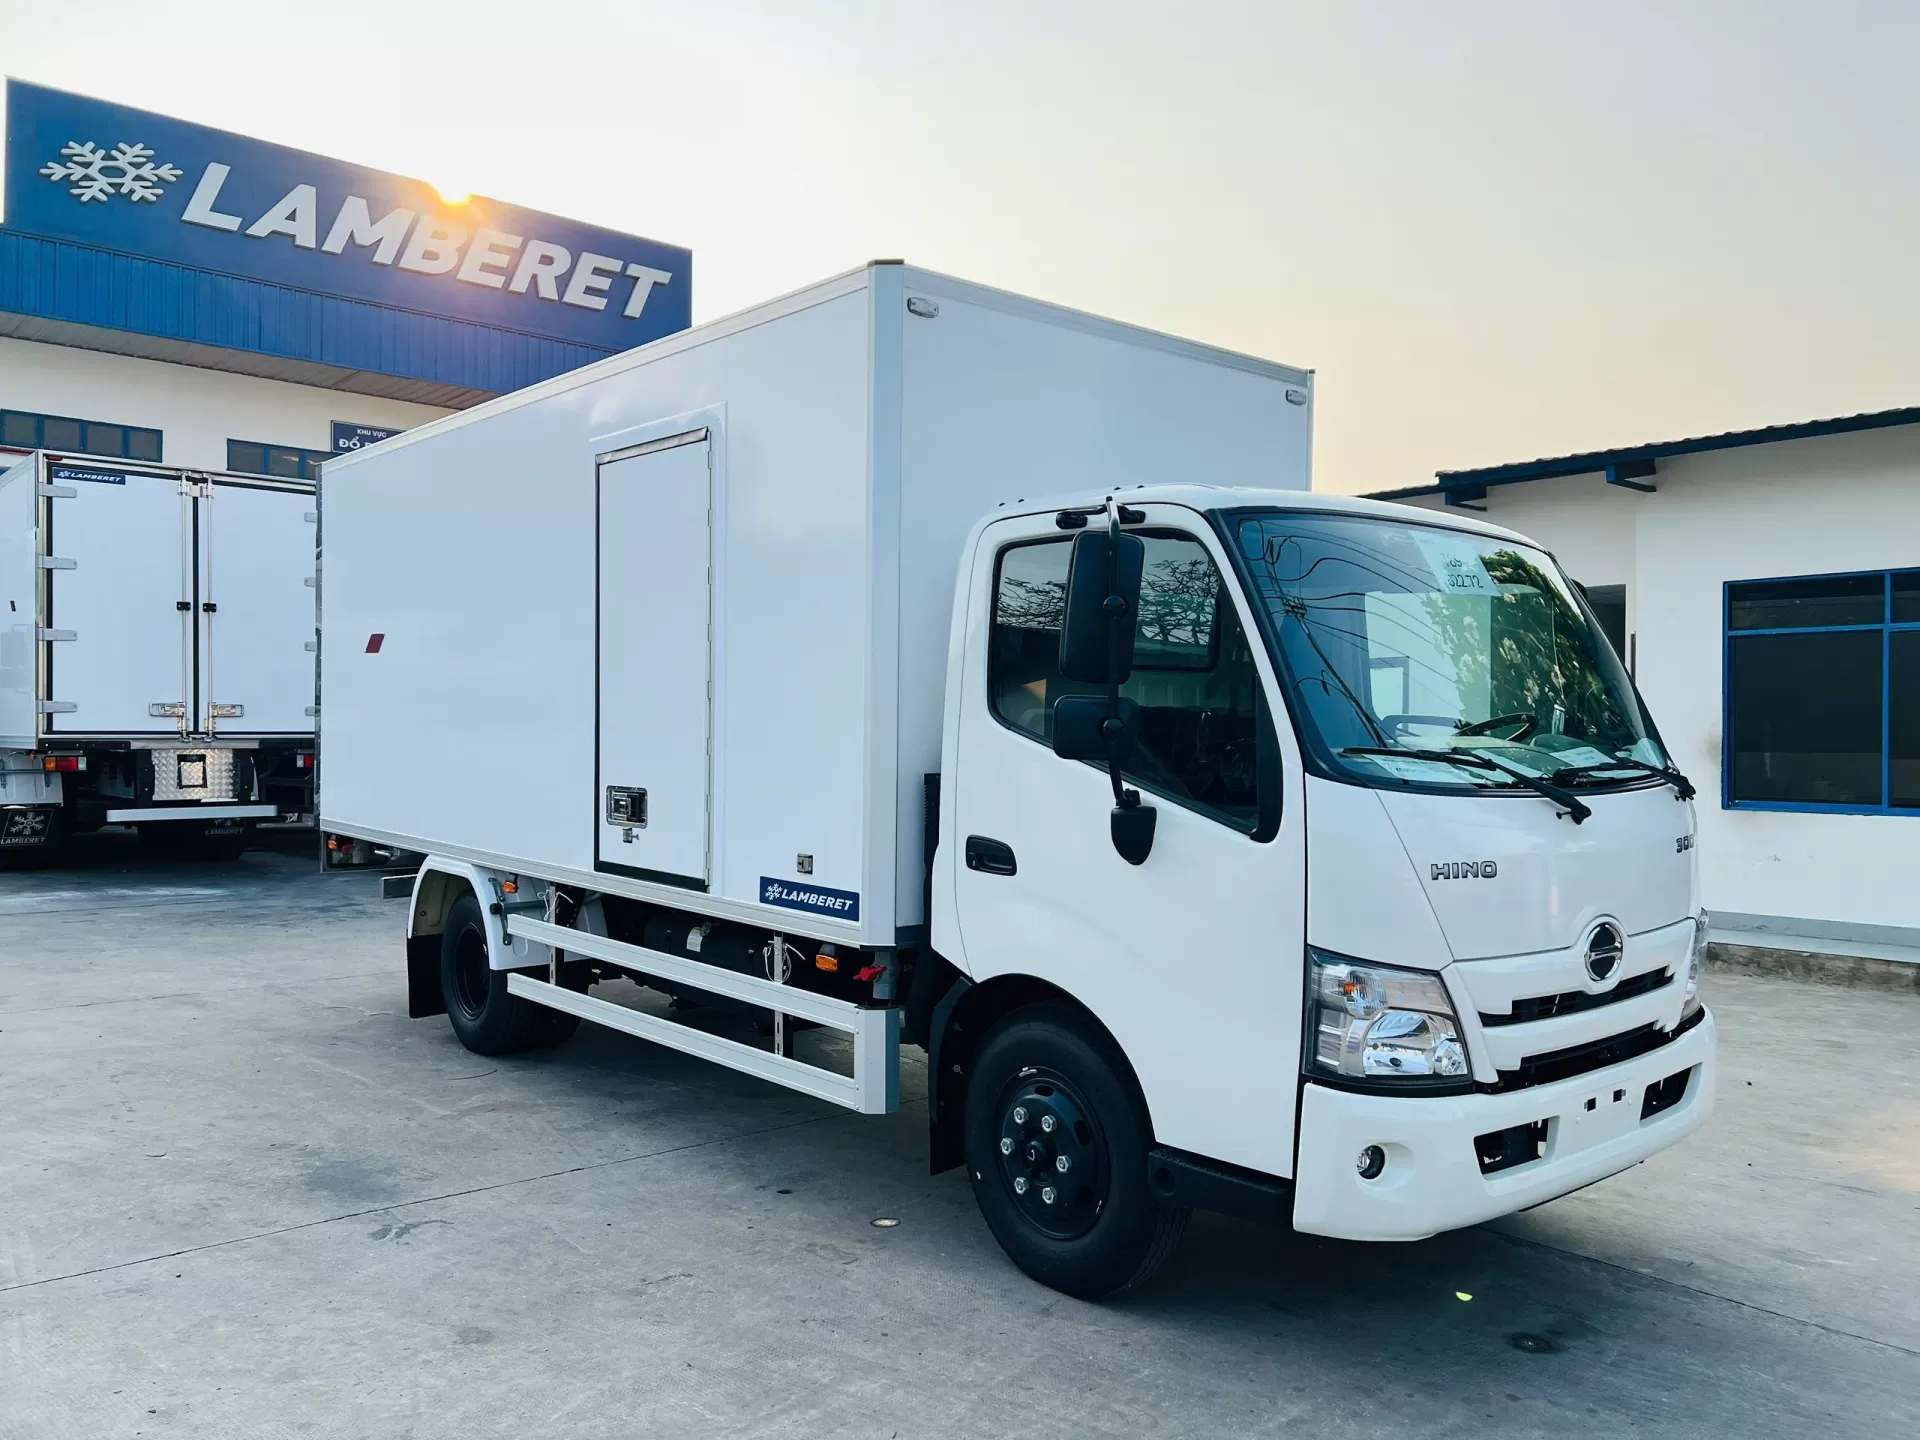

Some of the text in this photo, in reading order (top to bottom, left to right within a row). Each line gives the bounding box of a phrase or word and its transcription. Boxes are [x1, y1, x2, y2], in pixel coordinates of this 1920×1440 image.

[181, 162, 672, 319] LAMBERET
[357, 428, 371, 436] KHU
[71, 473, 122, 481] LAMBERET
[1676, 833, 1694, 853] 300
[1431, 861, 1497, 880] HINO
[781, 888, 853, 911] LAMBERET
